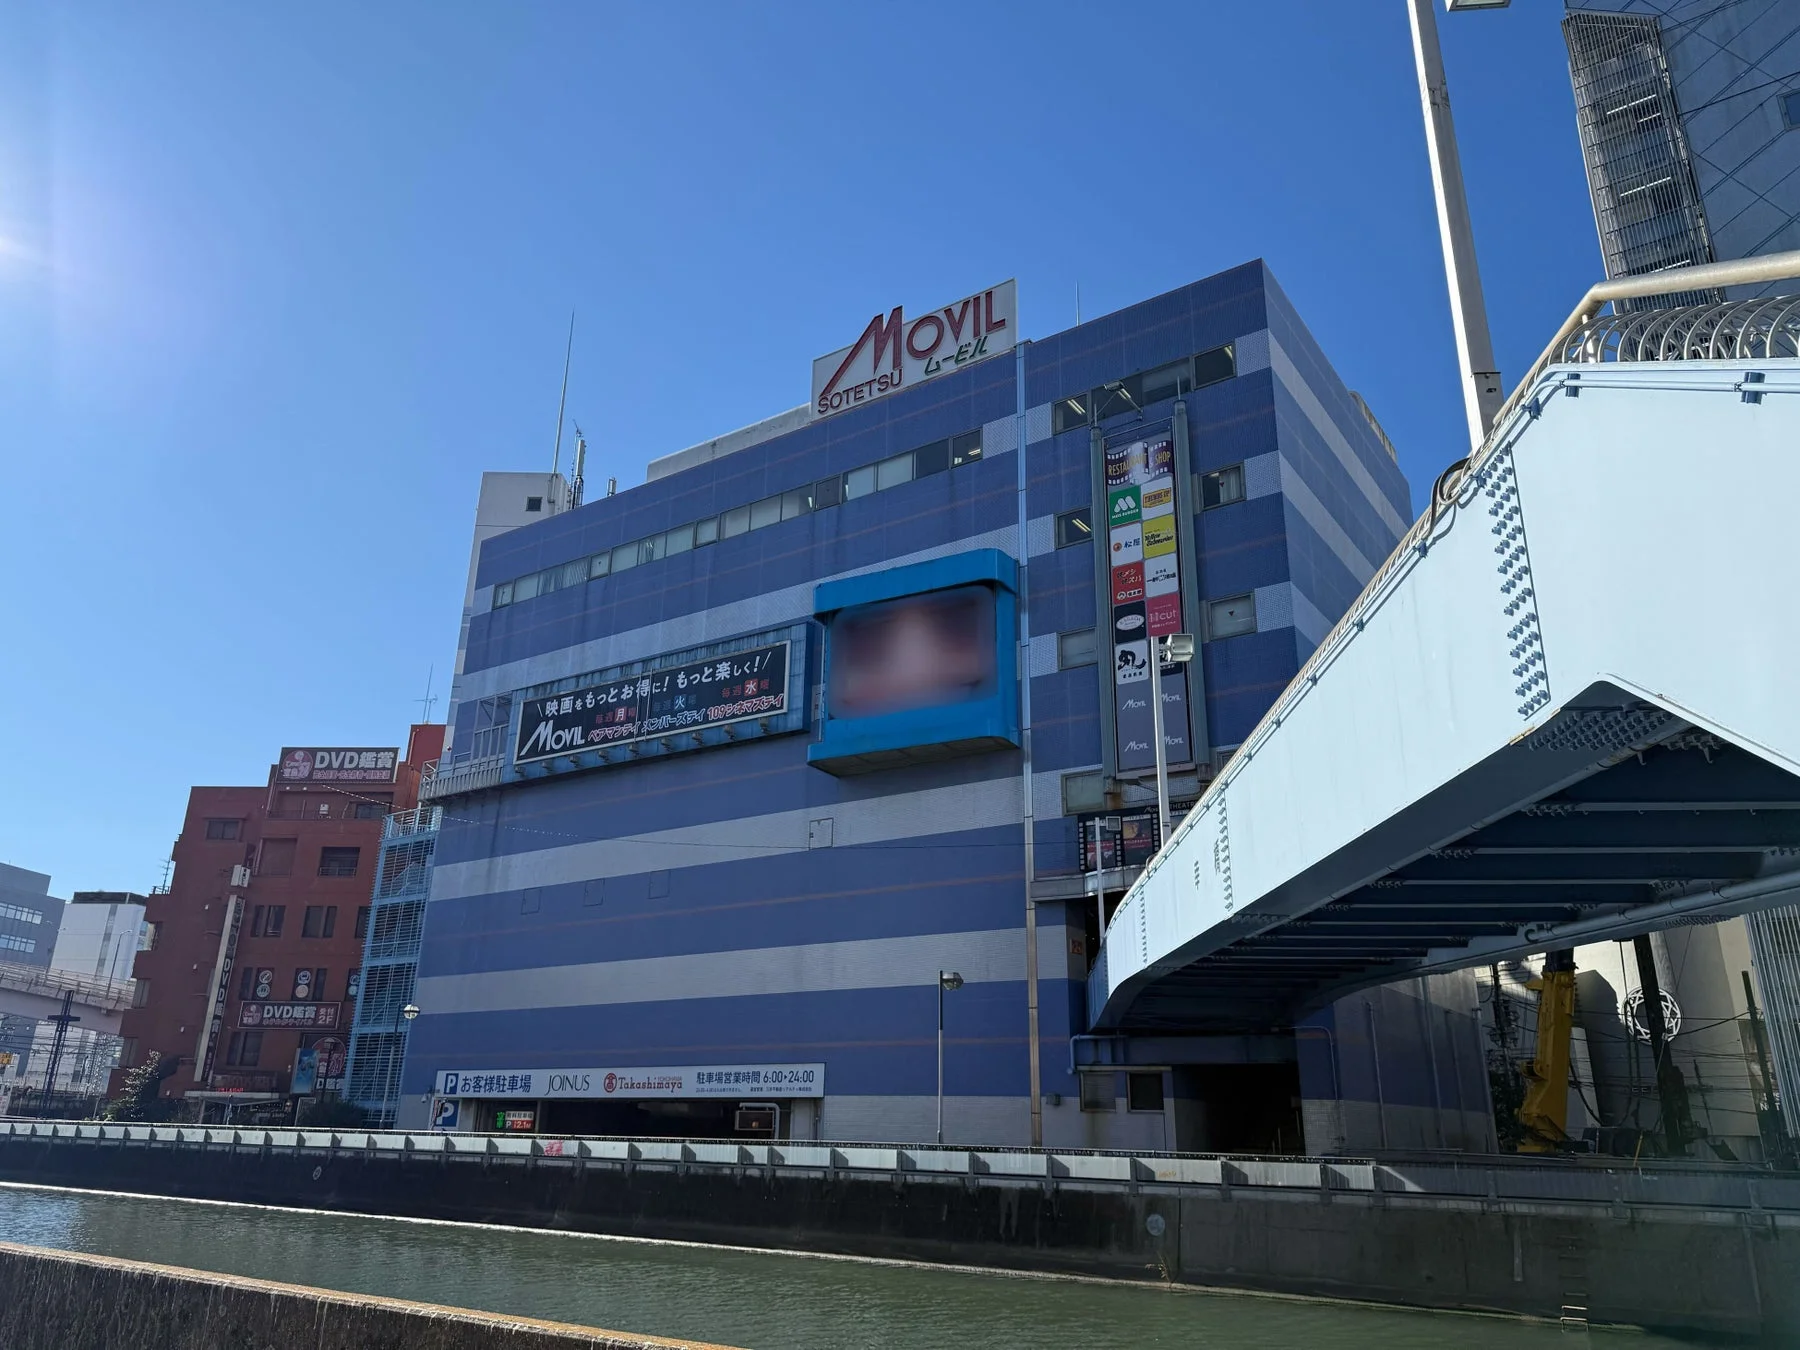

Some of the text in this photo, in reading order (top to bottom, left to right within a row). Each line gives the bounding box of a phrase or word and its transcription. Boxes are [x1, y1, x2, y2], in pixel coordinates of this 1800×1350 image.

[819, 290, 1006, 398] MOVIL
[924, 336, 988, 377] ムービル
[817, 368, 903, 415] SOTETSU
[1155, 450, 1171, 465] SHOP
[519, 719, 586, 757] MOVIL
[460, 1073, 532, 1094] お客様駐車場
[545, 1074, 590, 1096] JOINUS
[618, 1077, 683, 1093] Takashimaya
[696, 1070, 761, 1085] 駐車場営業時間
